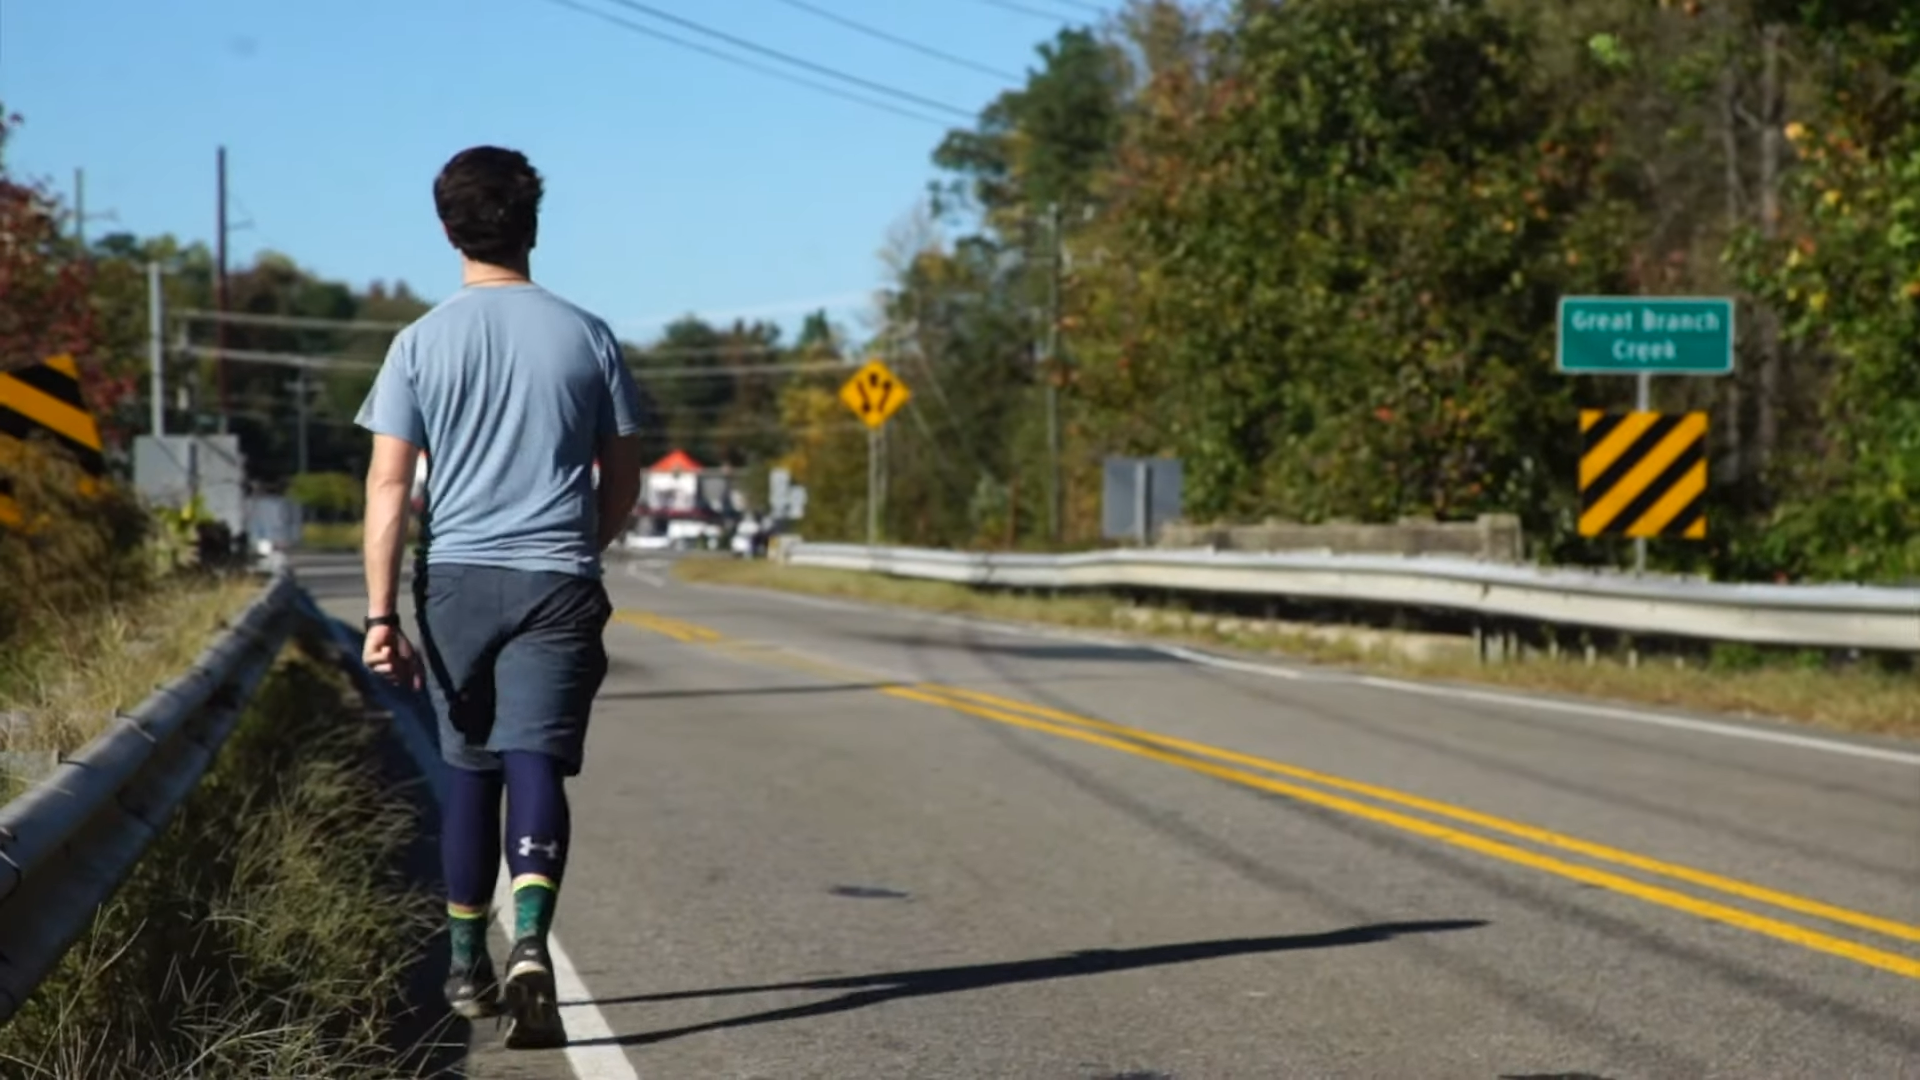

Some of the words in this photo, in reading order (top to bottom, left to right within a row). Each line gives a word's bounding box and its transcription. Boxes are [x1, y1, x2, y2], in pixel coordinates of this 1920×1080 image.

[1572, 309, 1633, 331] Great
[1642, 308, 1720, 332] Branch
[1612, 339, 1676, 361] Creek
